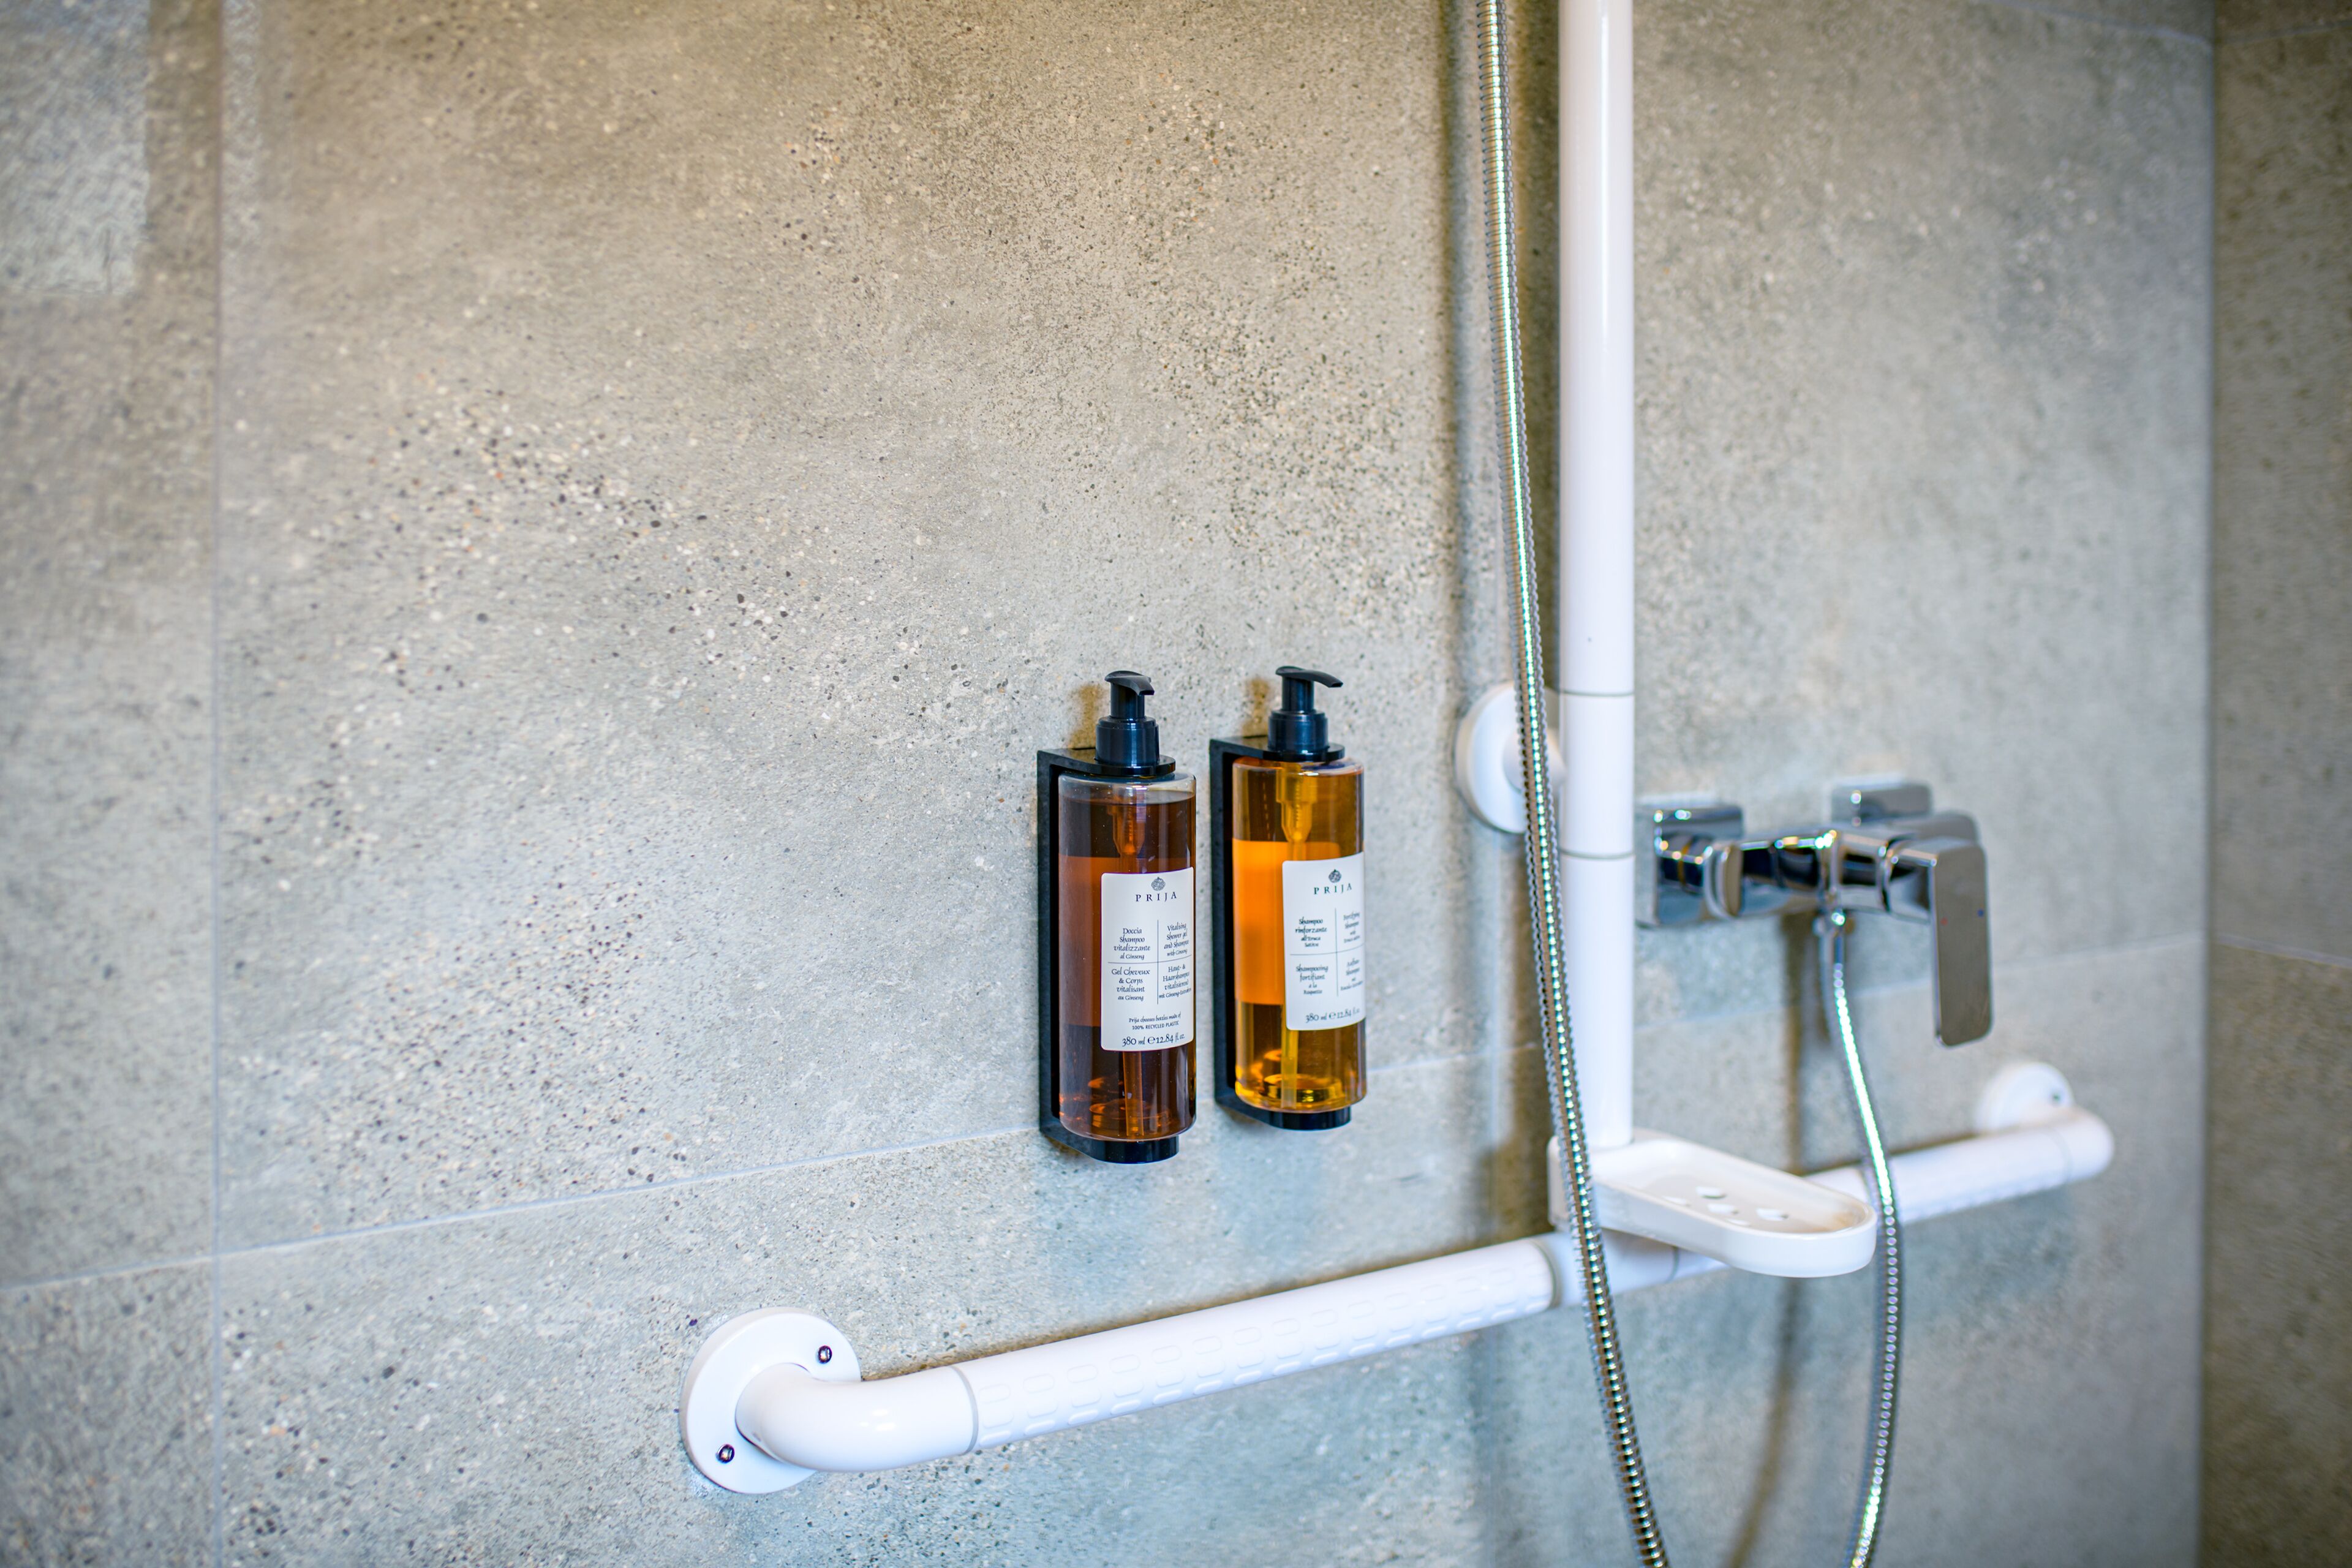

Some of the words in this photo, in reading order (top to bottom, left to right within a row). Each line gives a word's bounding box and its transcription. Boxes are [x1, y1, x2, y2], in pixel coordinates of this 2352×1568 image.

[1314, 883, 1352, 895] PRIJA
[1136, 892, 1177, 902] PRIJA
[1298, 916, 1323, 925] Shampoo
[1120, 934, 1145, 944] Shampoo
[1112, 967, 1122, 975] Gel
[1123, 967, 1150, 976] Cheveux
[1306, 1012, 1319, 1023] 380
[1122, 1036, 1137, 1047] 380
[1138, 1036, 1145, 1045] ml
